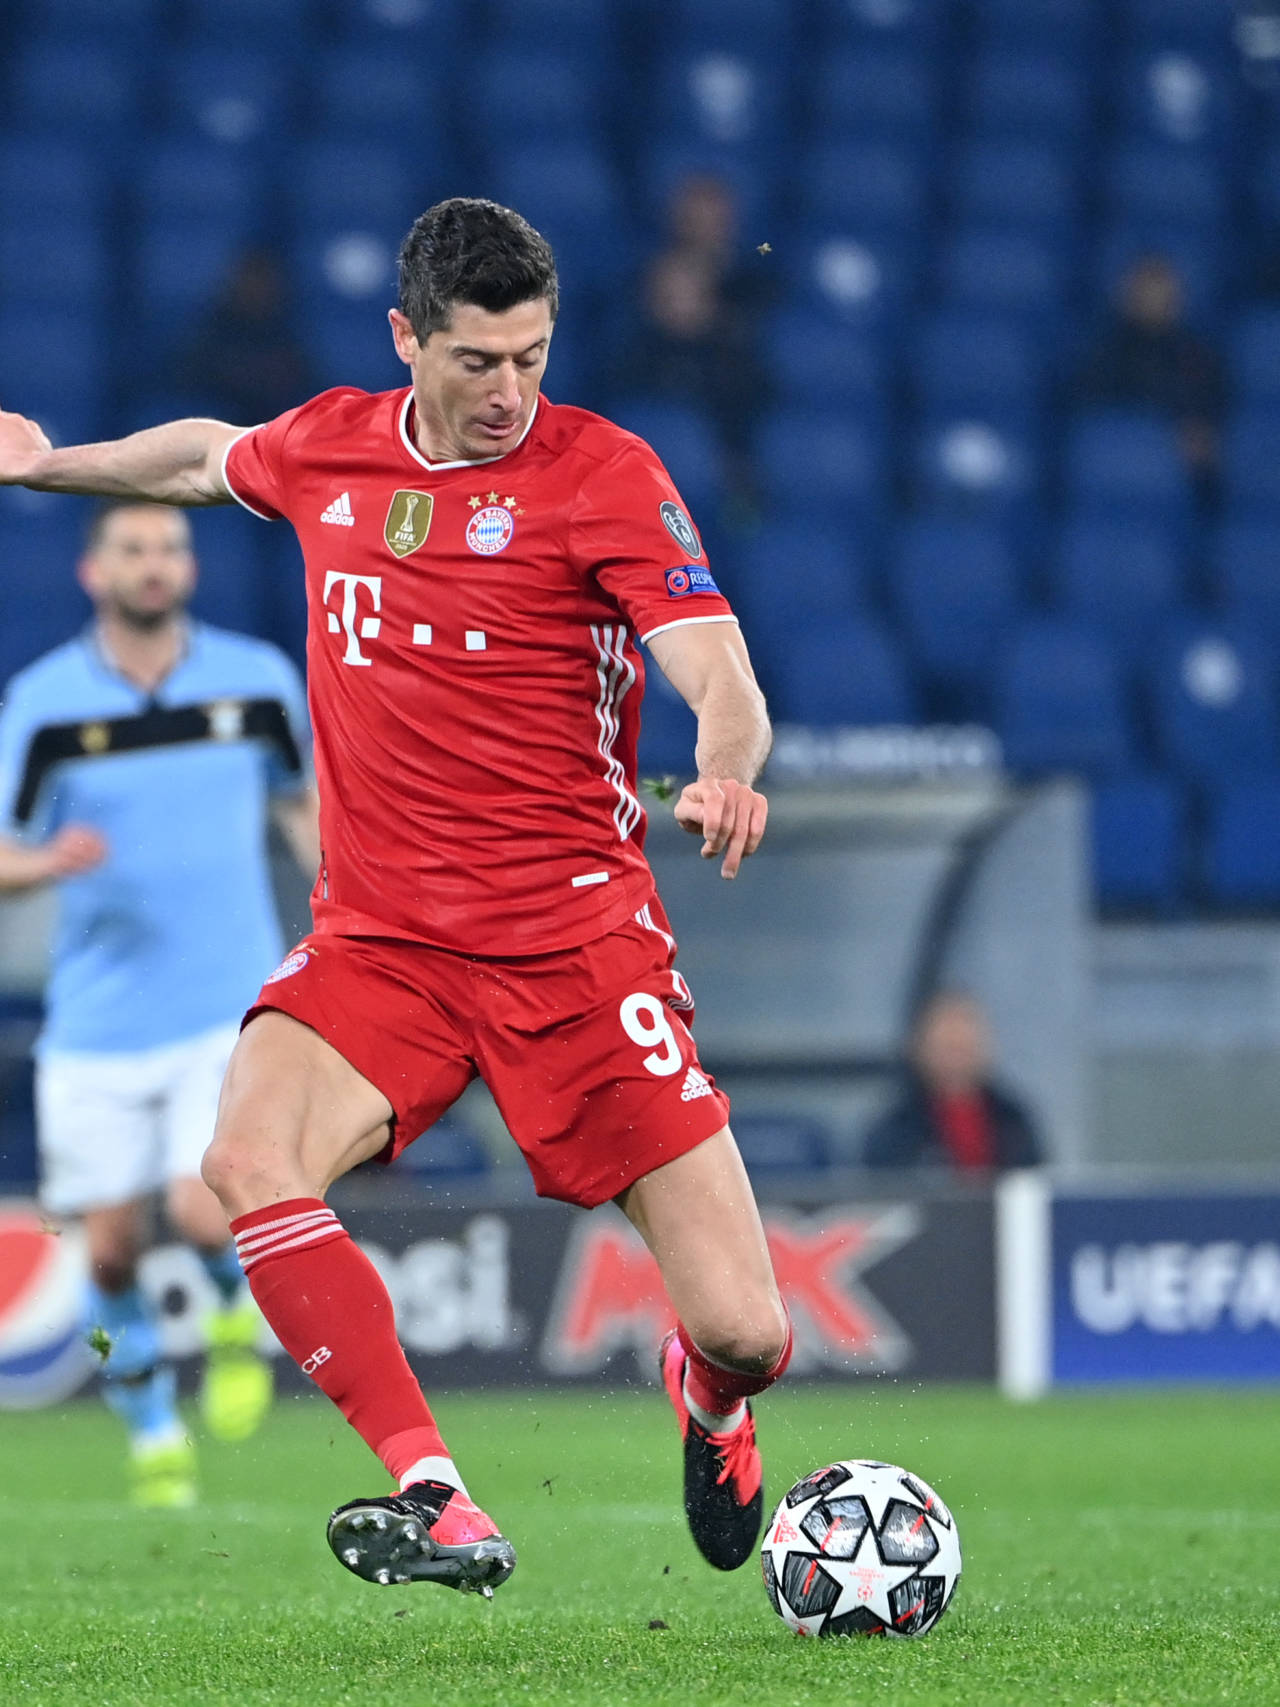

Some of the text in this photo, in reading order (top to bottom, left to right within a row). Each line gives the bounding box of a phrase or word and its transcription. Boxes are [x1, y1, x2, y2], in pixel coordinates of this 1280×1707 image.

[320, 511, 355, 527] adidas
[394, 531, 414, 542] FIFA
[690, 572, 717, 587] RESP
[620, 992, 682, 1076] 9
[680, 1084, 713, 1102] adida
[1071, 1241, 1280, 1335] UEFA
